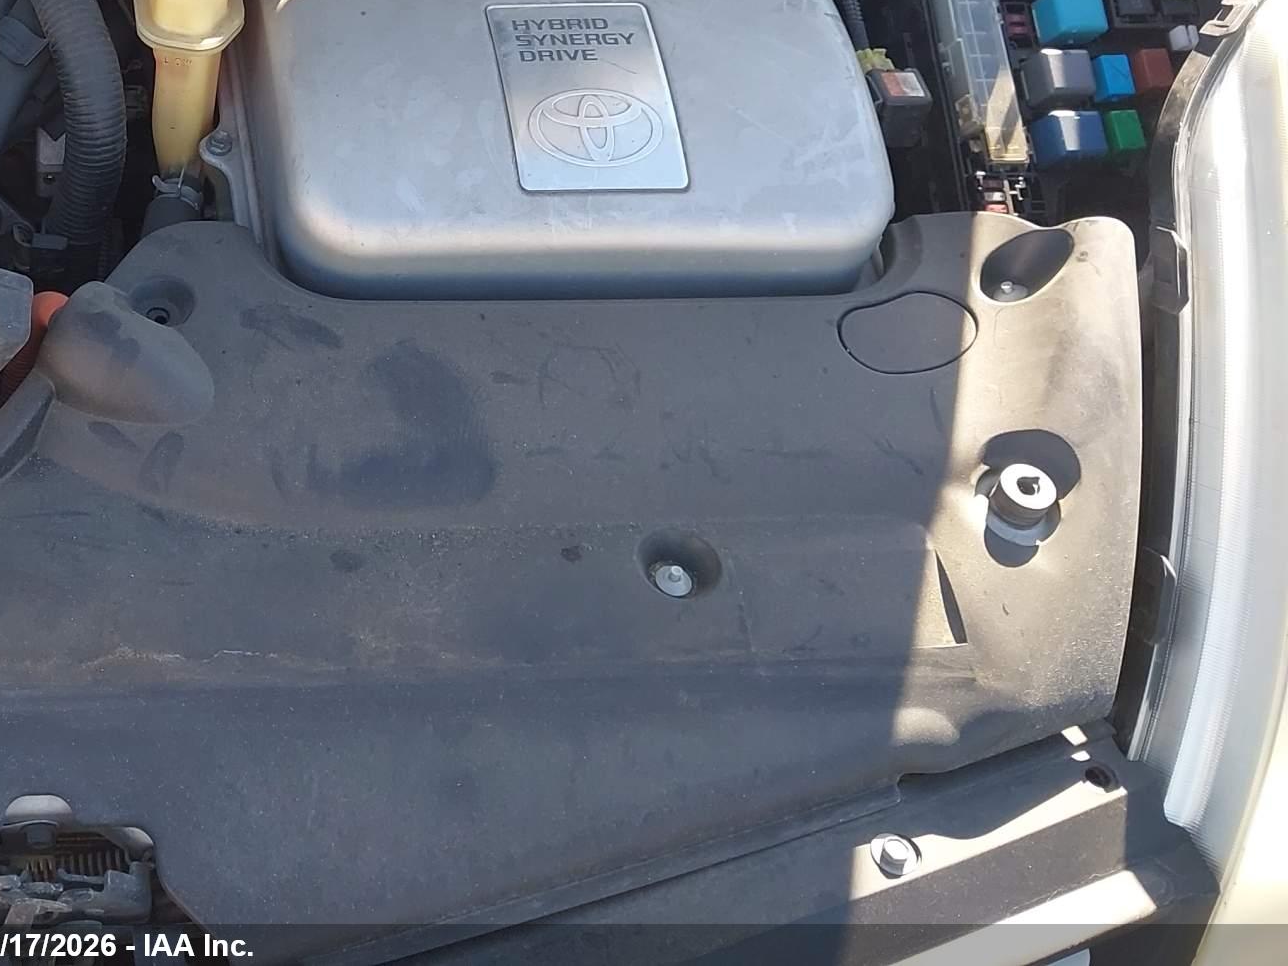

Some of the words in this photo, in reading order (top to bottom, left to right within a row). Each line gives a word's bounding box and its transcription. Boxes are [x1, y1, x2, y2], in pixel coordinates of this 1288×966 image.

[512, 18, 609, 31] HYBRID
[515, 32, 634, 46] SYNERGY
[519, 48, 598, 62] DRIVE
